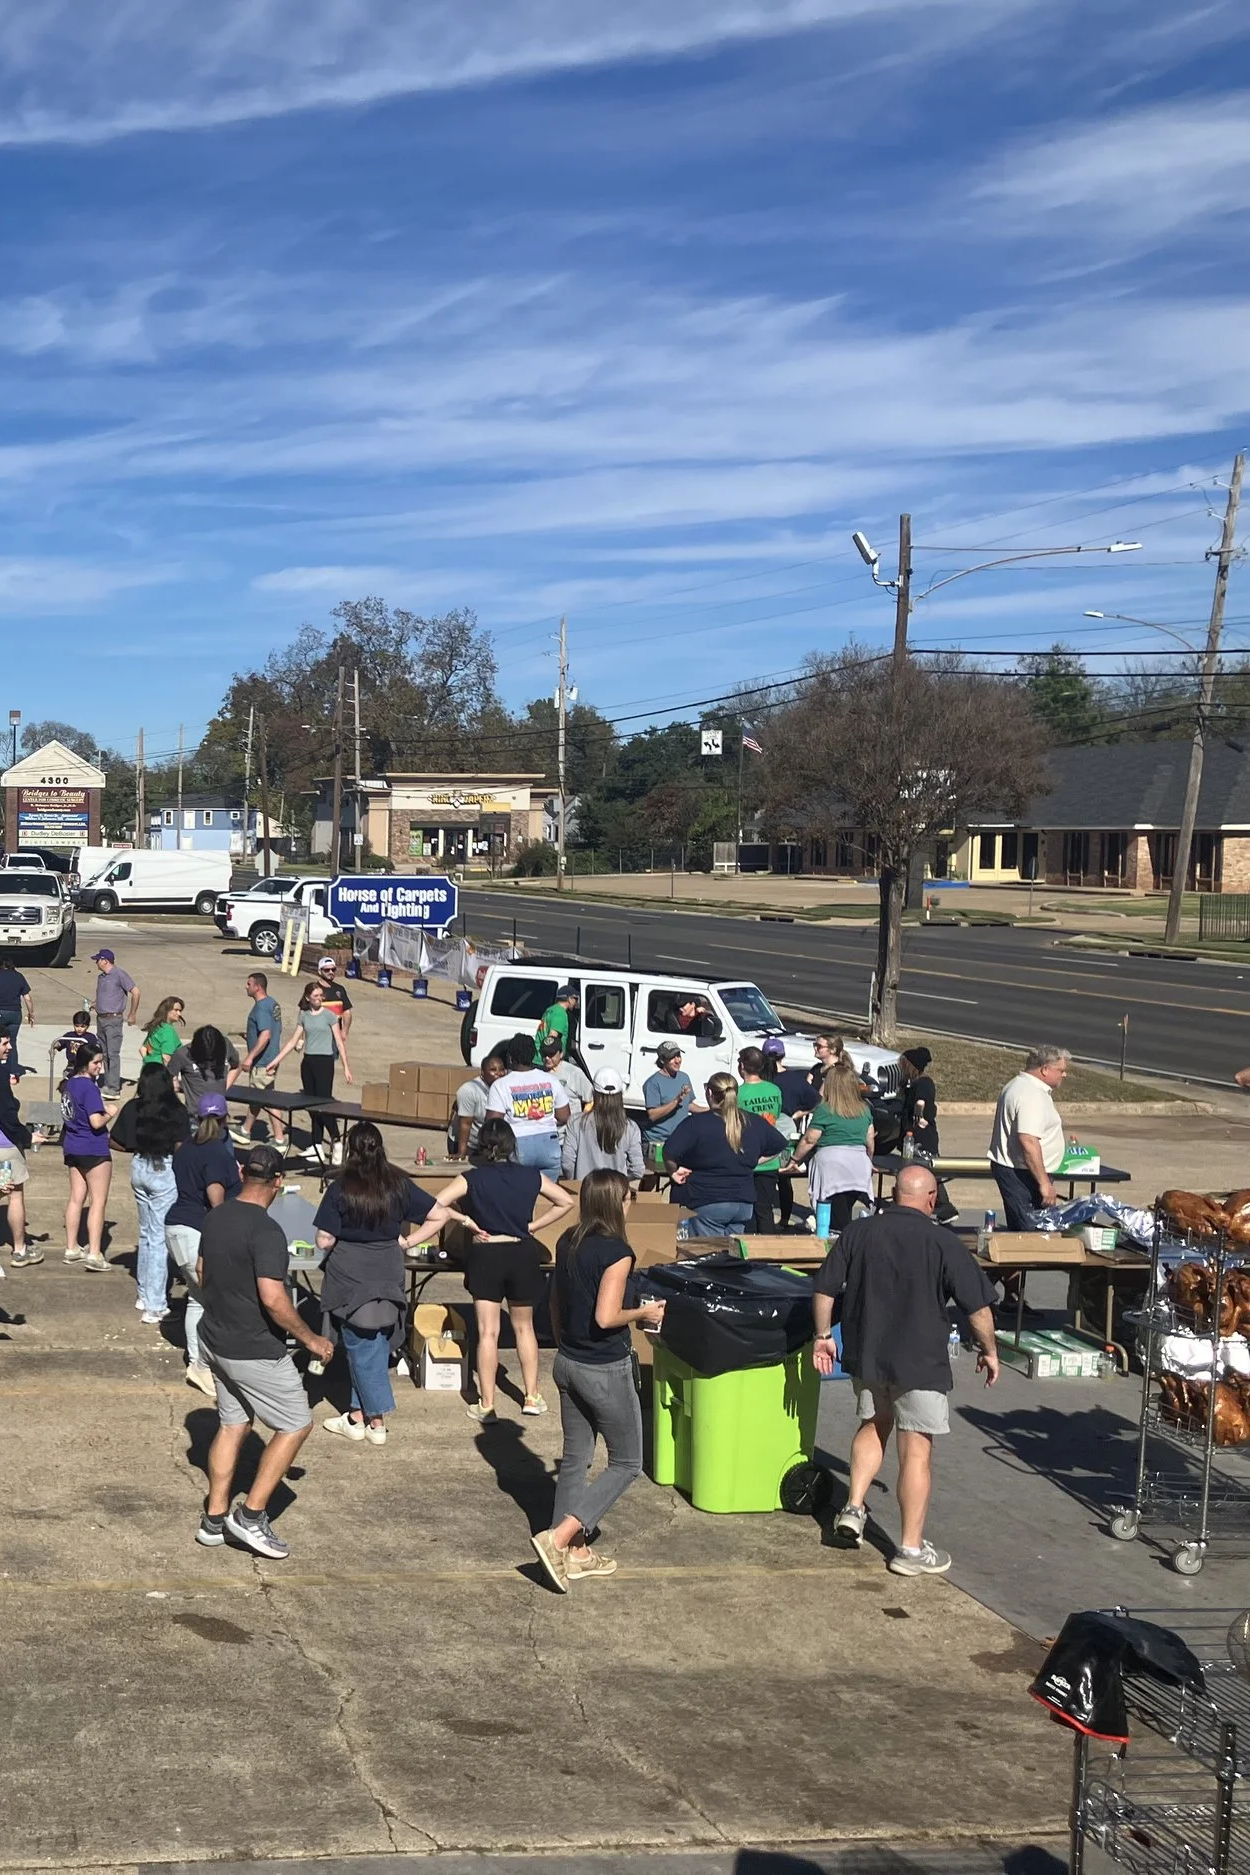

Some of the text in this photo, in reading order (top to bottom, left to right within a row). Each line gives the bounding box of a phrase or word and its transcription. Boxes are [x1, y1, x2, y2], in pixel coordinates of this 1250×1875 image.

[21, 789, 49, 798] Bridges
[59, 789, 86, 798] Beauty
[338, 887, 448, 905] House of Carpets
[360, 903, 430, 920] And Lighting
[752, 1103, 775, 1112] CREW
